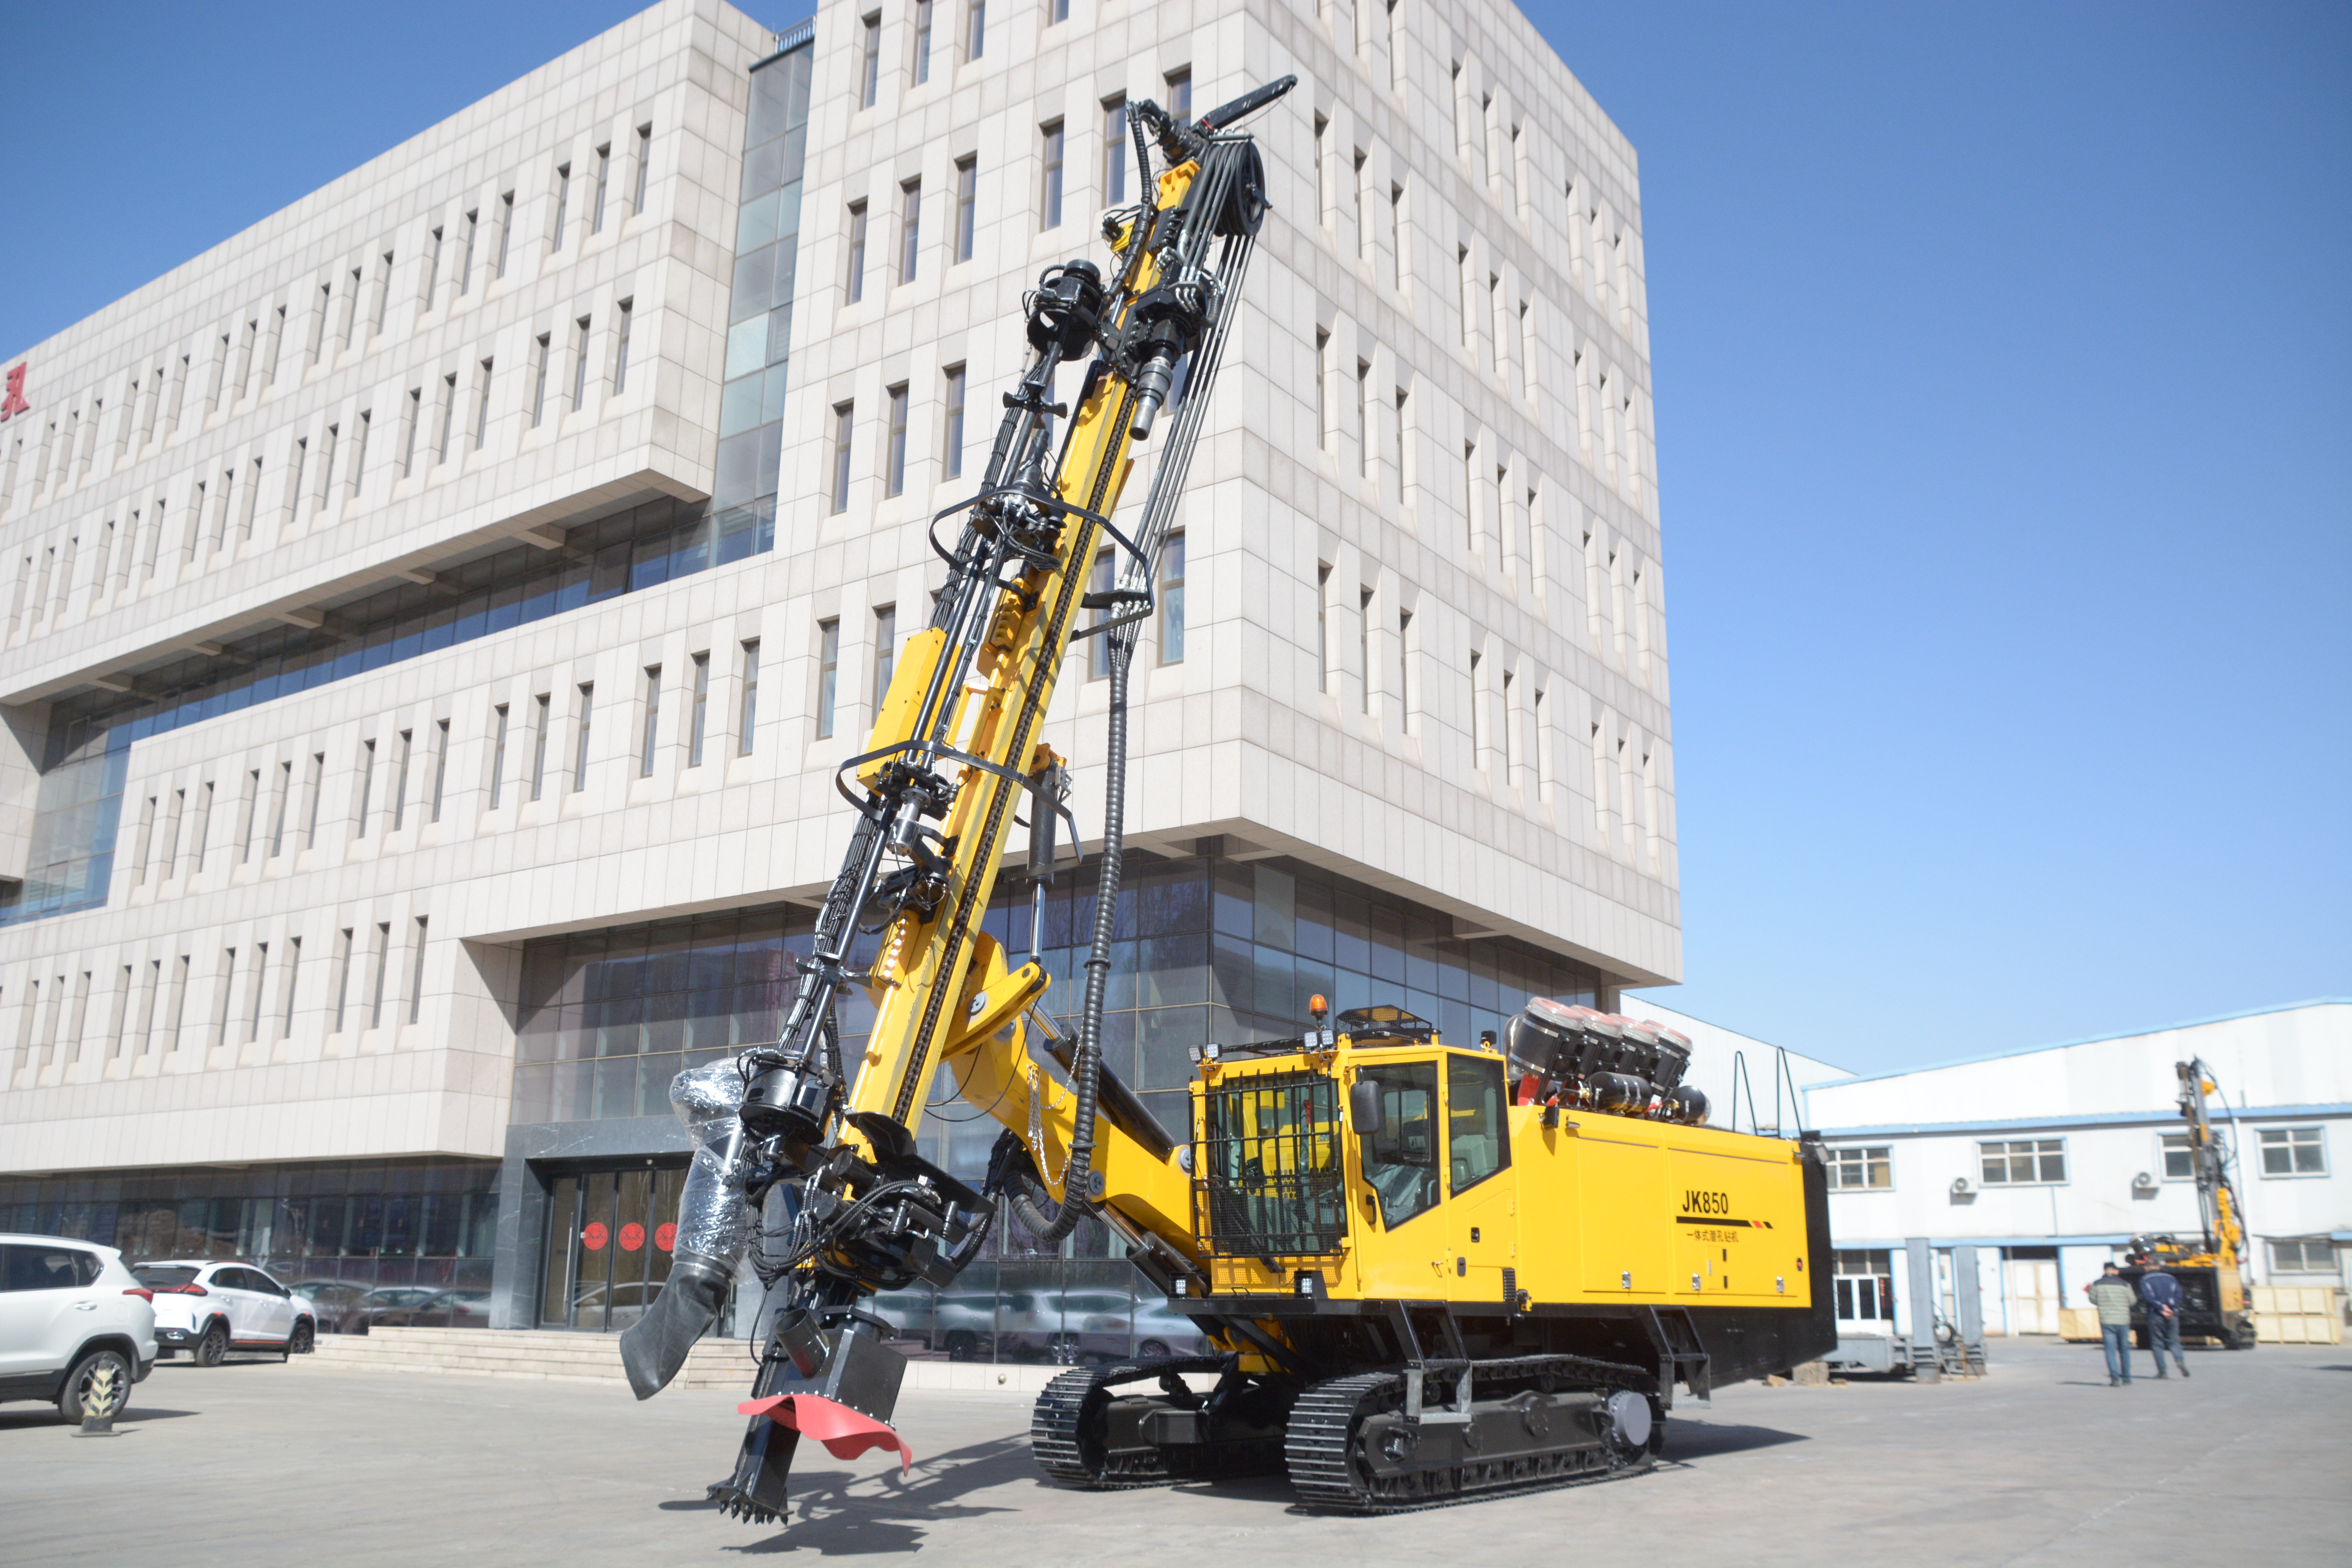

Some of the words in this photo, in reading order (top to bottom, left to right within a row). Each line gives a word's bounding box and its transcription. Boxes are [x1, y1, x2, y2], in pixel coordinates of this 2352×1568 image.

[1682, 1190, 1728, 1214] JK850
[1686, 1229, 1739, 1243] 一体式潜孔钻机
